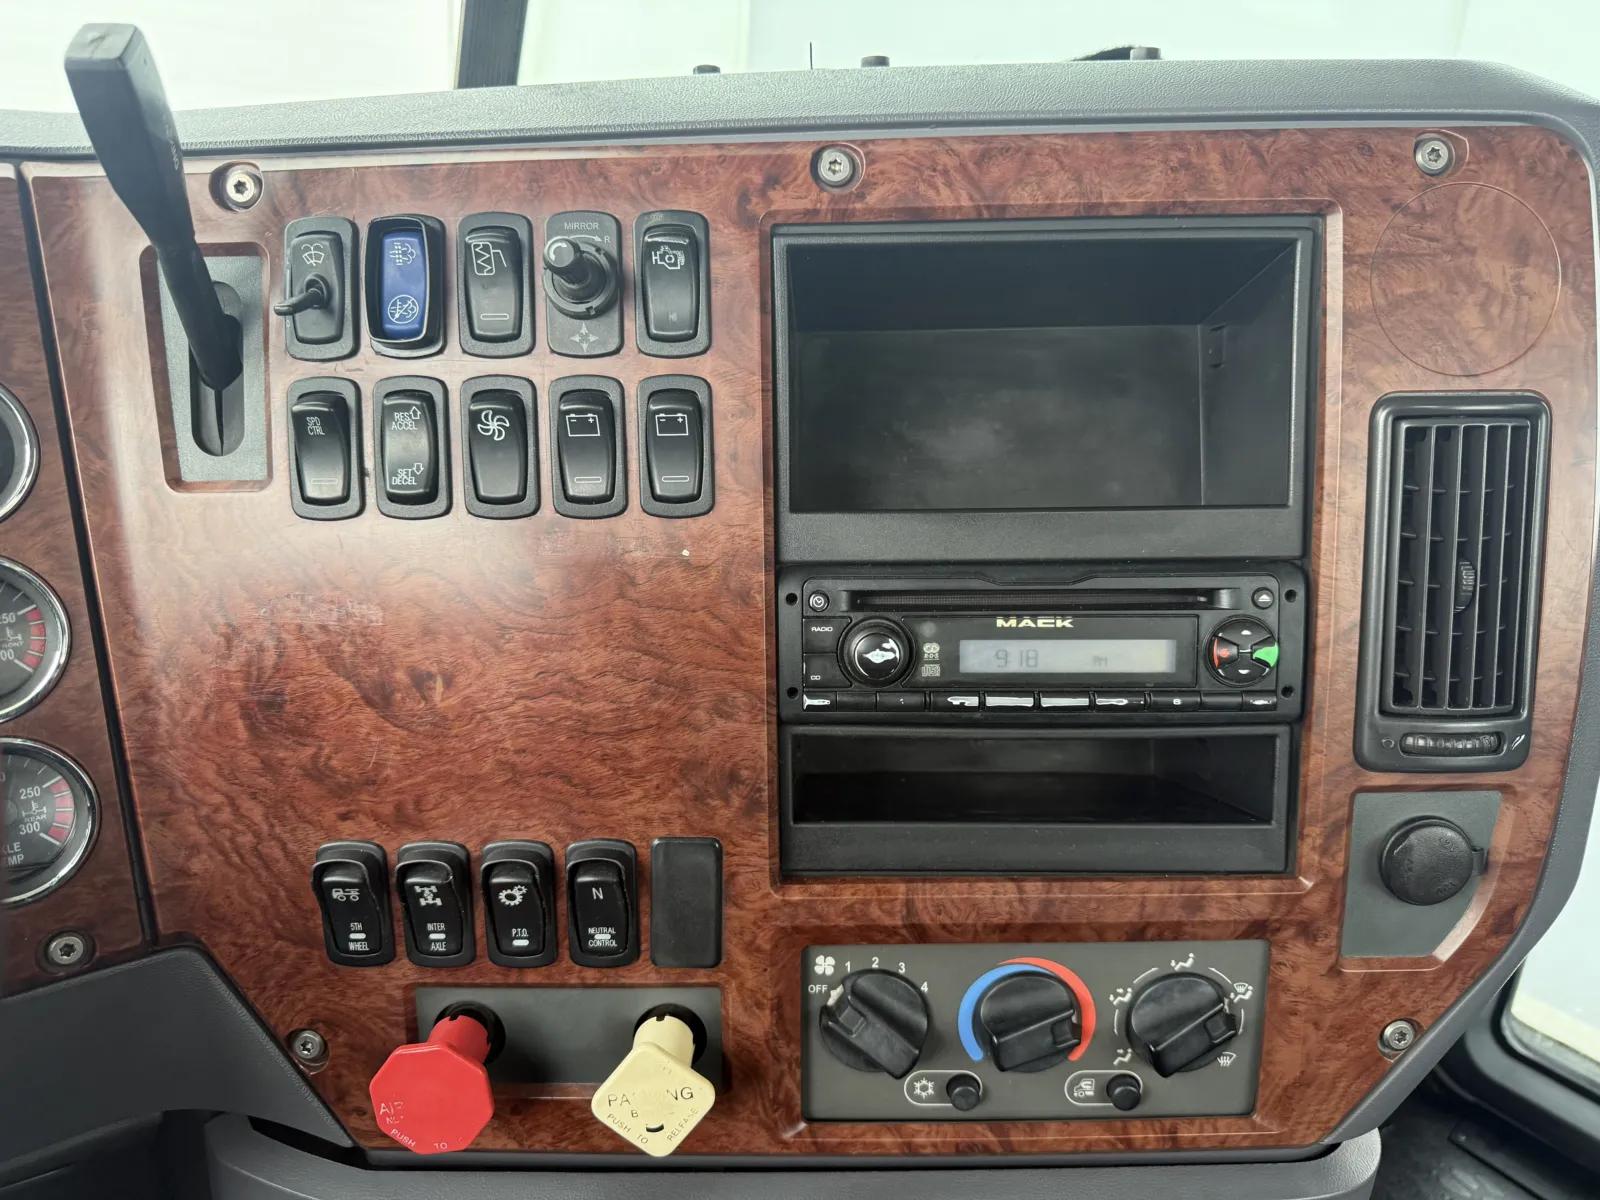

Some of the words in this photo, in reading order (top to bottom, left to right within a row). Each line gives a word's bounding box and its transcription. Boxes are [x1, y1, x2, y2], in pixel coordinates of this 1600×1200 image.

[564, 222, 599, 230] MIRROR
[604, 236, 611, 244] R
[306, 416, 320, 426] SPD
[391, 420, 418, 430] ACCEL
[308, 426, 325, 436] CTRL
[397, 468, 412, 478] SET
[391, 477, 417, 486] DECEL
[0, 612, 16, 624] 50
[996, 616, 1074, 628] MACK
[19, 785, 41, 799] 250
[19, 821, 41, 835] 300
[591, 887, 604, 900] N
[350, 922, 363, 931] 5TH
[426, 922, 446, 931] INTER
[587, 926, 617, 935] NEUTRAL
[348, 941, 369, 951] WHEEL
[430, 941, 447, 951] AXLE
[588, 939, 618, 948] CONTROL
[844, 960, 851, 972] 1
[871, 956, 879, 968] 2
[898, 962, 906, 973] 3
[920, 981, 928, 992] 4
[807, 984, 828, 993] OFF
[607, 1086, 694, 1107] PANG
[606, 1113, 631, 1133] PUSH
[391, 1128, 416, 1148] PUSH
[433, 1142, 448, 1150] TO
